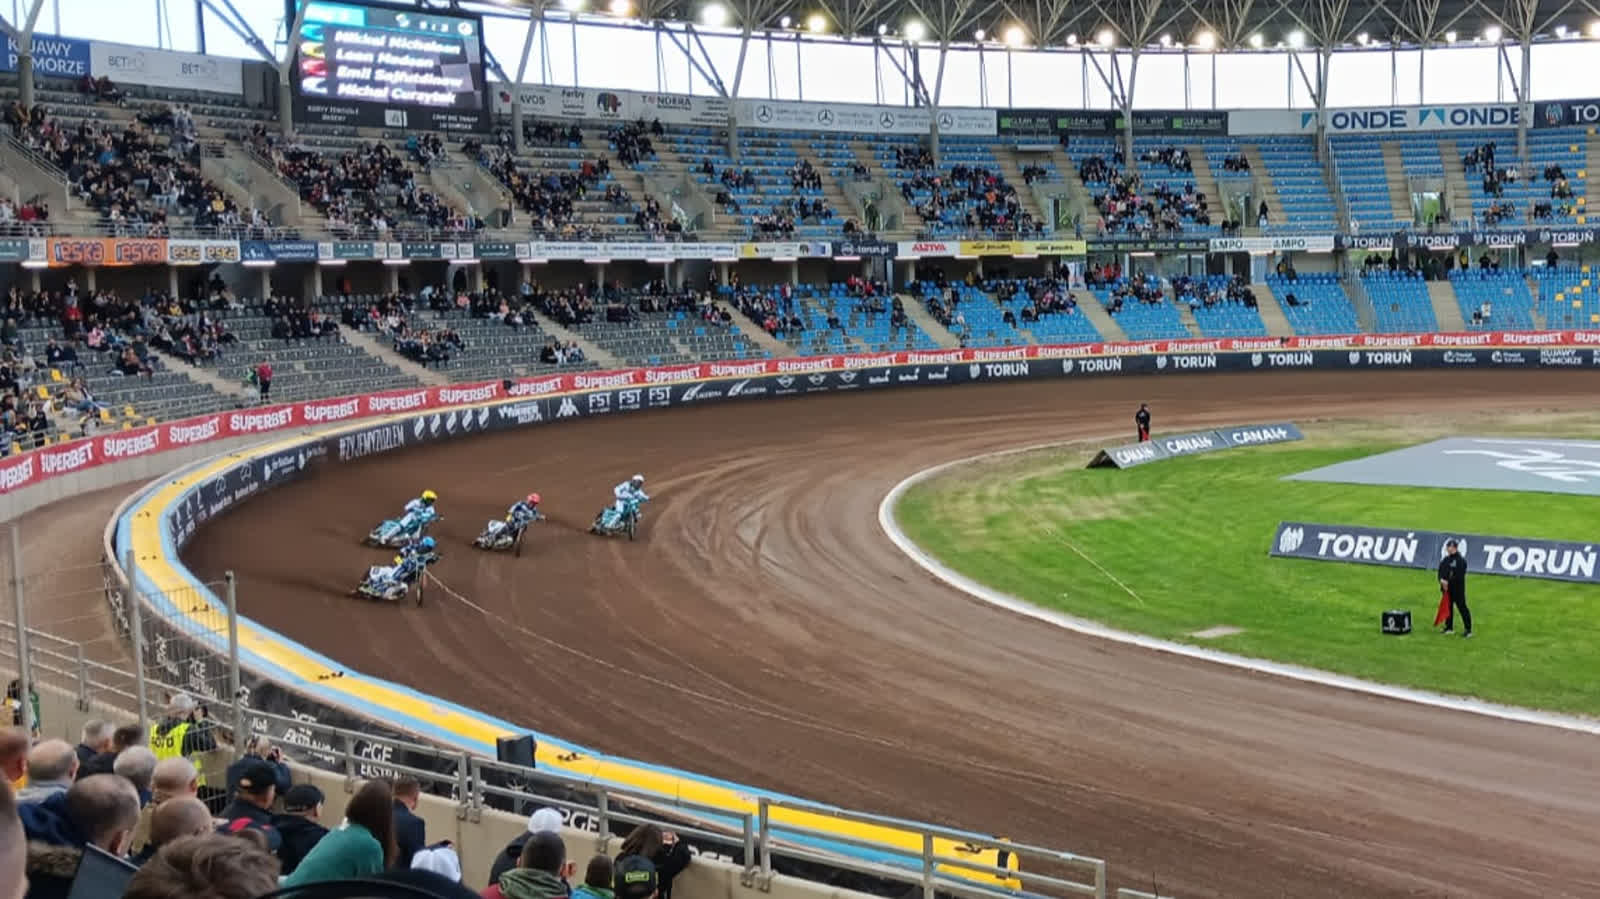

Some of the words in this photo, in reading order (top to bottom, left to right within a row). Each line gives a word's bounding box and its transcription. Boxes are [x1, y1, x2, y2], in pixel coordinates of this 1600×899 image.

[8, 38, 72, 57] KJAWY
[8, 55, 85, 75] PMORZE
[1331, 110, 1407, 129] ONDE
[1449, 107, 1521, 126] ONDE
[1551, 230, 1594, 243] TORUŃ
[1232, 339, 1287, 350] SUPERBE
[1298, 337, 1354, 347] SUPERBET
[1365, 335, 1422, 346] SUPERBET
[1434, 334, 1492, 345] SUPERBET
[907, 351, 964, 364] SUPERBET
[974, 348, 1027, 361] SUPERBET
[1038, 346, 1092, 358] SUPERBET
[1103, 344, 1157, 355] SUPERBET
[1366, 350, 1411, 364] TORUŃ
[777, 358, 833, 372] SUPERBET
[844, 355, 897, 369] SUPERBET
[1078, 357, 1122, 372] TORUŃ
[1173, 353, 1216, 368] TORUŃ
[1268, 352, 1313, 366] TORUŃ
[645, 366, 702, 384] SUPERBET
[709, 361, 766, 377] SUPERBET
[986, 360, 1029, 376] TORUŃ
[575, 371, 635, 389] SUPERBET
[369, 391, 427, 411] SUPERBET
[439, 384, 498, 403] SUPERBET
[589, 392, 612, 408] FST
[618, 389, 642, 404] FST
[649, 386, 672, 401] FST
[304, 399, 359, 421] SUPERBET
[230, 408, 292, 431] SUPERBET
[169, 416, 220, 443] SUPERBET
[1232, 427, 1288, 444] CANAL+
[104, 429, 159, 457] SUPERBET
[41, 442, 93, 473] SUPERBET
[1318, 532, 1418, 563] TORUŃ
[1483, 545, 1597, 577] TORUŃ
[361, 742, 393, 764] PGE
